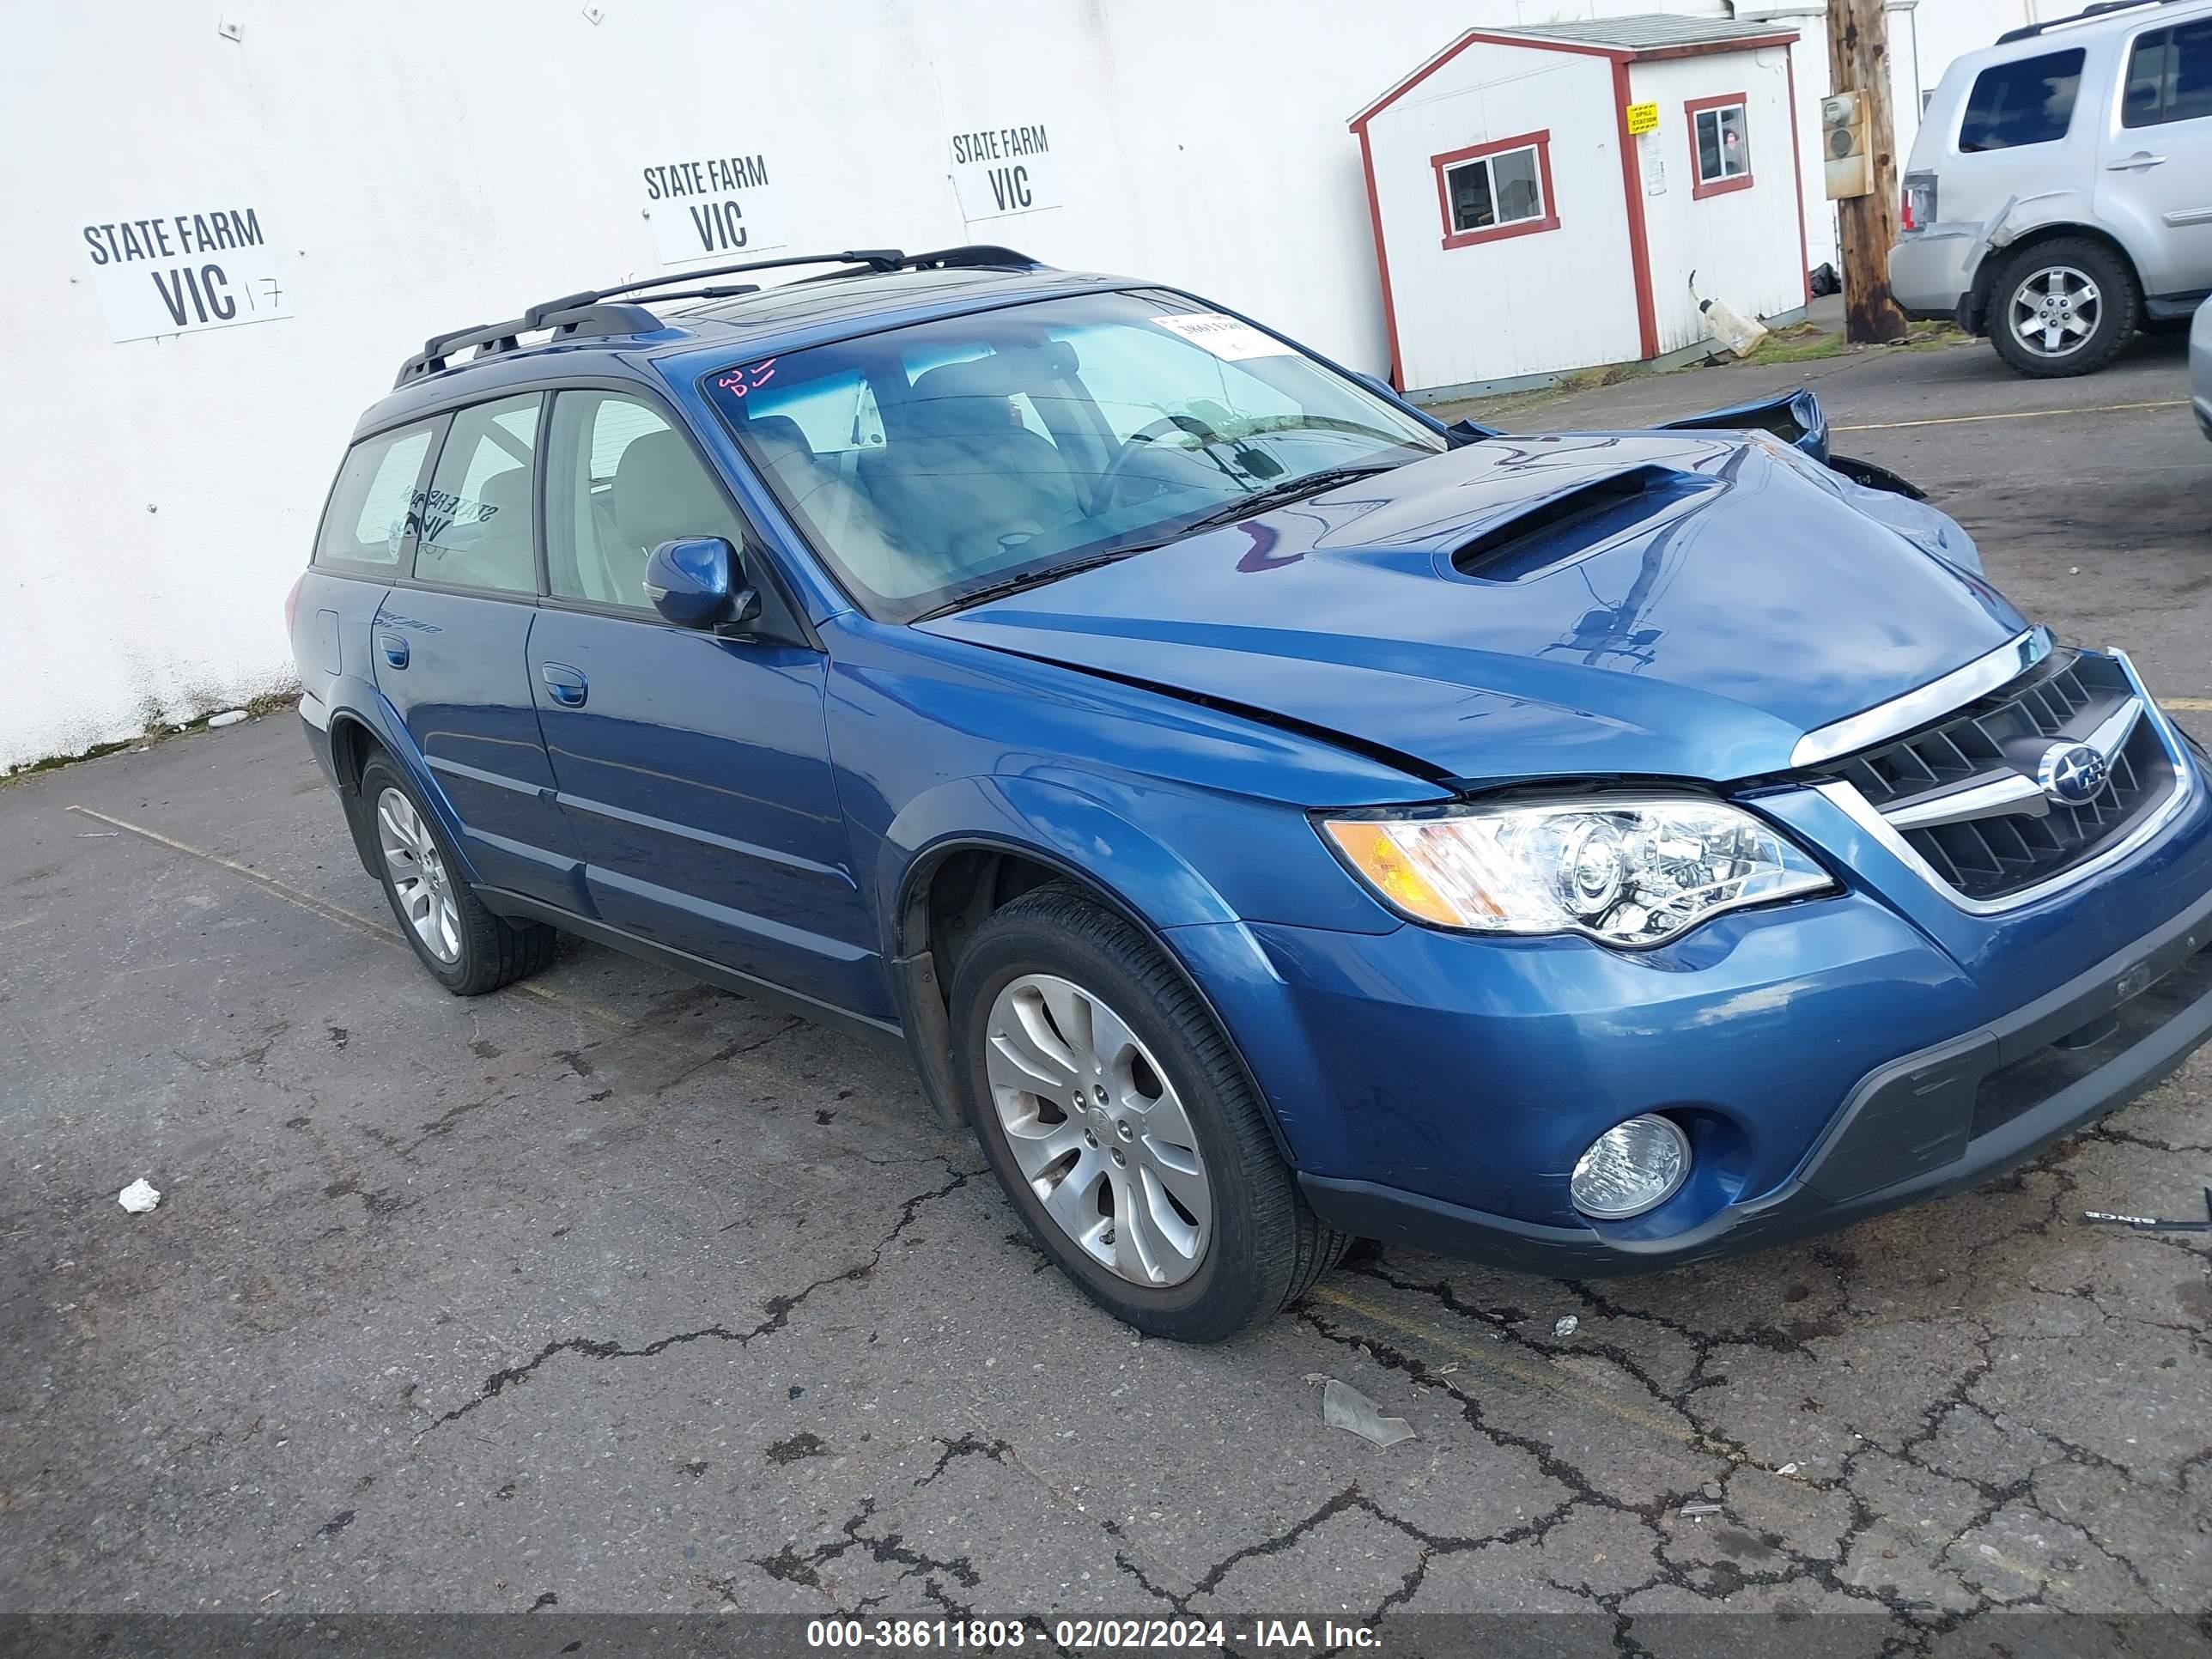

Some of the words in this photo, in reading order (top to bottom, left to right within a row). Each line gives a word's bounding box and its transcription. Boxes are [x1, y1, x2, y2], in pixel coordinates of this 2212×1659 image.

[1632, 117, 1657, 125] STATION
[952, 131, 1001, 164] STATE
[1000, 125, 1049, 158] FARM
[643, 161, 707, 200] STATE
[707, 155, 769, 192] FARM
[988, 165, 1032, 211] VIC
[83, 218, 175, 265] STATE
[174, 208, 264, 254] FARM
[690, 200, 747, 252] VIC
[150, 264, 236, 326] VIC
[2084, 1211, 2156, 1224] SINCE
